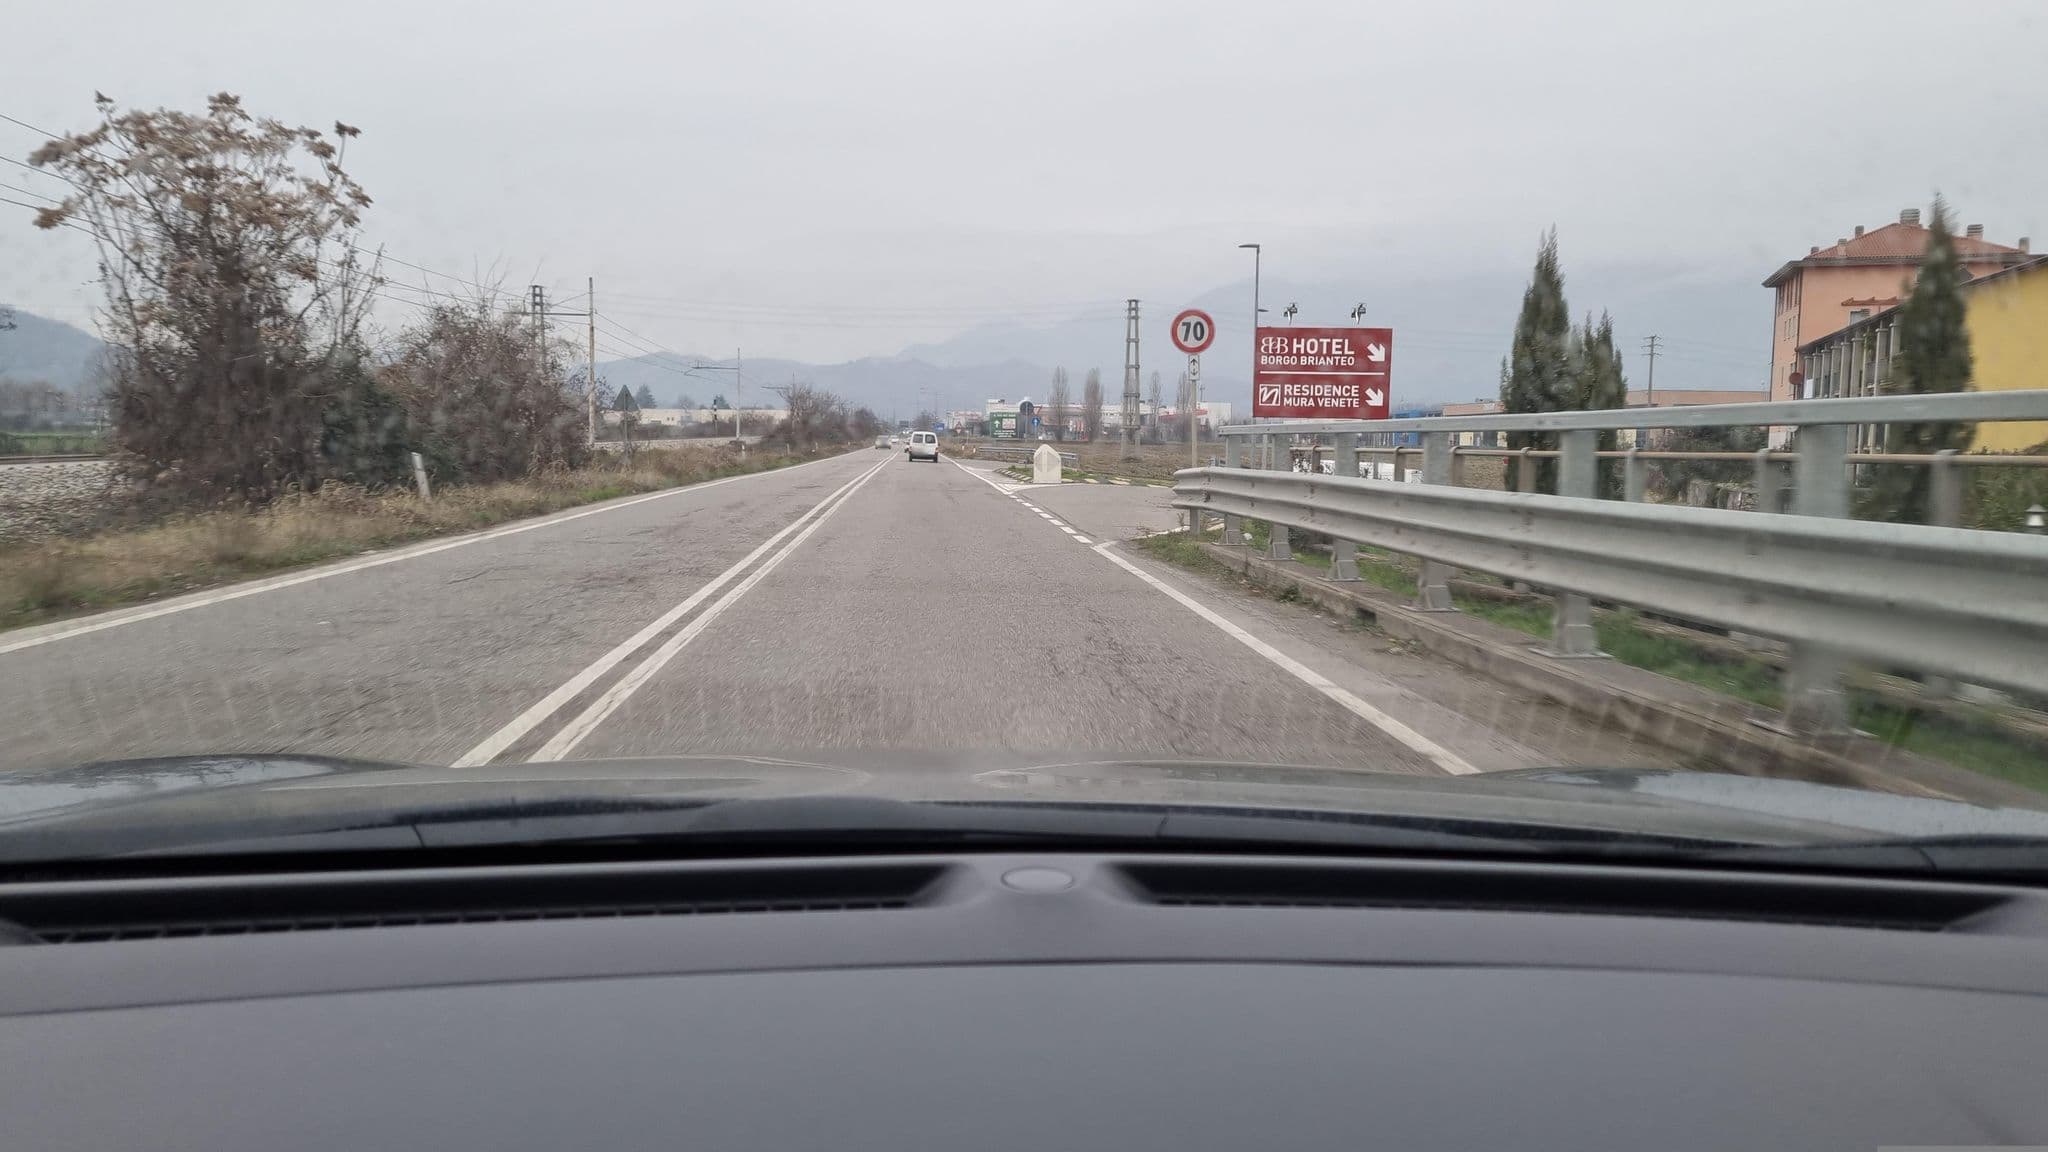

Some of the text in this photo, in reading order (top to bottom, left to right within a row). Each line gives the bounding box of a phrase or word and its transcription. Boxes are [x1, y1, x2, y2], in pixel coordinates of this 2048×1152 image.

[1181, 321, 1205, 342] 70
[1292, 338, 1355, 355] HOTEL
[1260, 355, 1355, 366] BORGO BRIANTEO
[1284, 384, 1360, 397] RESIDENCE
[1283, 397, 1360, 408] MURA VENETE
